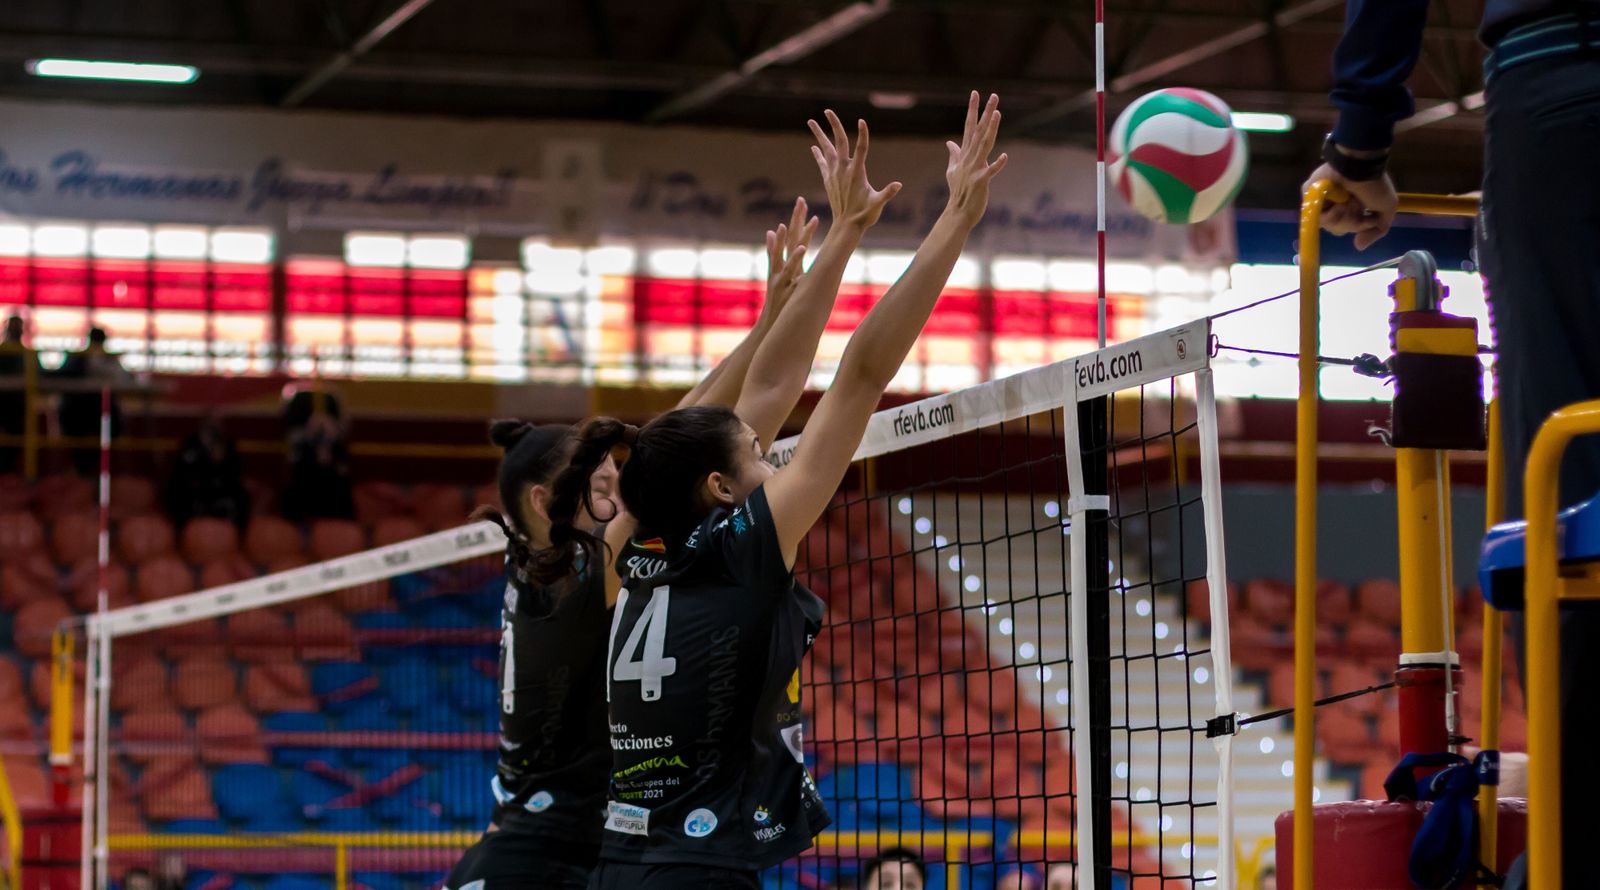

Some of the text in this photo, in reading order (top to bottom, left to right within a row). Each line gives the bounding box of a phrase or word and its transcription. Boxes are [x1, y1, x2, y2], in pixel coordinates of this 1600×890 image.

[893, 404, 954, 437] rfevb.com
[607, 584, 677, 702] 14
[666, 777, 680, 786] del
[643, 789, 664, 799] 2021
